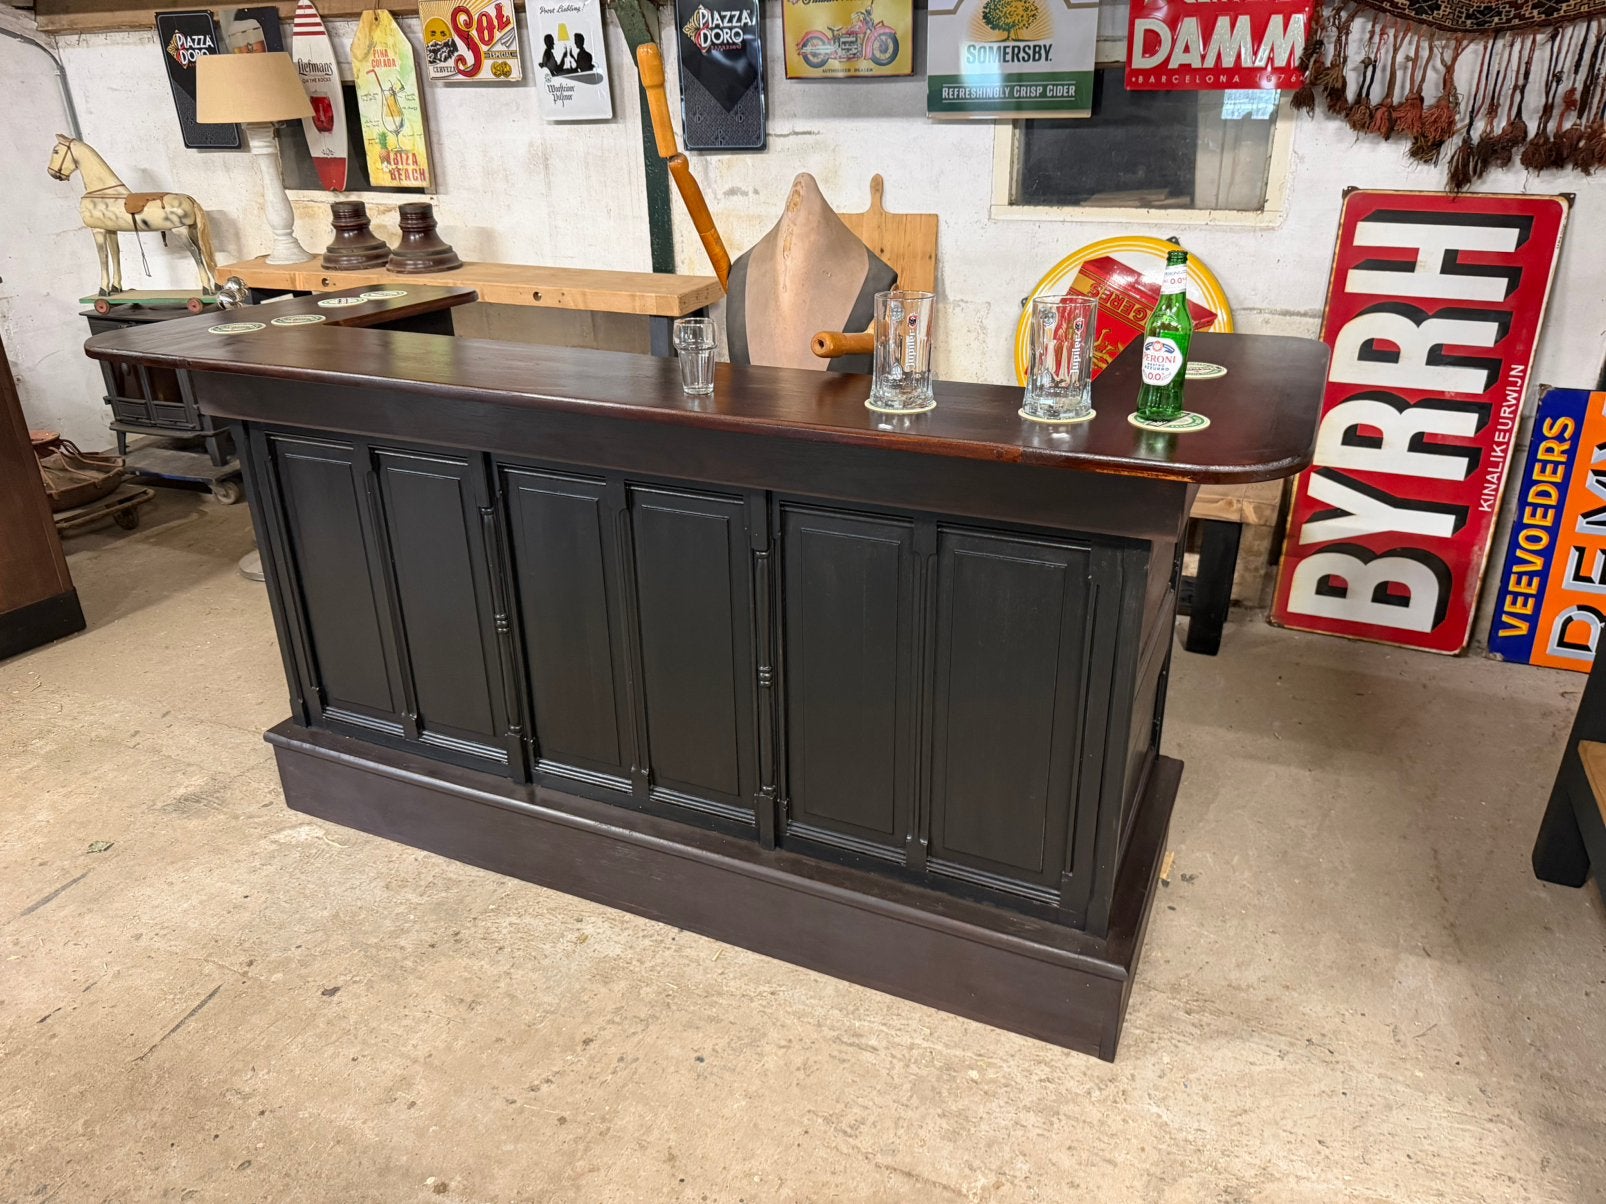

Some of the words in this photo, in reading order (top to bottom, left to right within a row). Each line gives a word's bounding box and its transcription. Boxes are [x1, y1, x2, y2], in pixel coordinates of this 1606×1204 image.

[700, 9, 752, 28] PIAZZA
[176, 33, 214, 49] PIAZZA
[451, 2, 511, 77] SOL
[1131, 14, 1305, 69] DAMM
[298, 58, 334, 76] Liefmans
[1138, 75, 1240, 83] BARCELONA
[942, 86, 1010, 99] REFRESHINGLY
[1014, 85, 1043, 97] CRISP
[1047, 85, 1076, 97] CIDER
[389, 168, 427, 181] BEACH
[1089, 283, 1148, 324] GERES
[906, 330, 916, 370] Jupiler
[1070, 336, 1081, 374] Jupiler
[1143, 352, 1176, 363] PERONI
[1287, 210, 1533, 633] BYRRH
[1478, 364, 1526, 512] KINALIKEURWIJN
[1498, 416, 1576, 637] VEEVOEDERS
